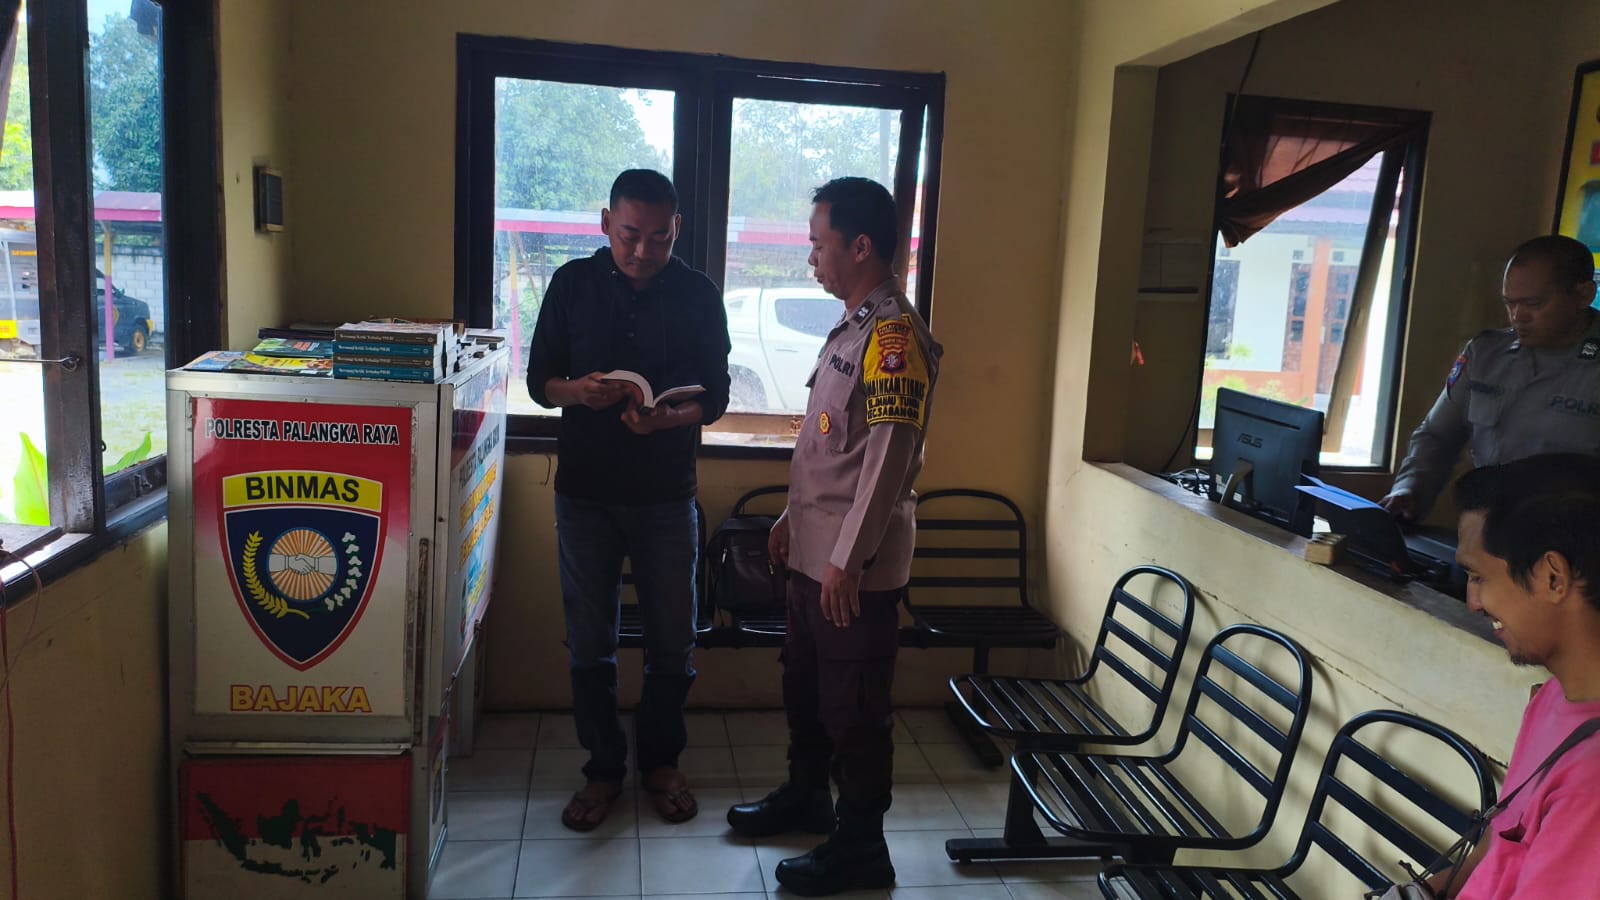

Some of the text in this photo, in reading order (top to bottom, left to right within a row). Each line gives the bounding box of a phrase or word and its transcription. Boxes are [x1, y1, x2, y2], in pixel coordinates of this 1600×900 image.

[829, 354, 856, 377] POLRI
[1550, 395, 1600, 415] POLR
[204, 418, 400, 445] POLRESTA PALANGKA RAYA
[1237, 432, 1264, 449] ASUS
[245, 475, 360, 502] BINMAS
[230, 684, 371, 713] BAJAKA
